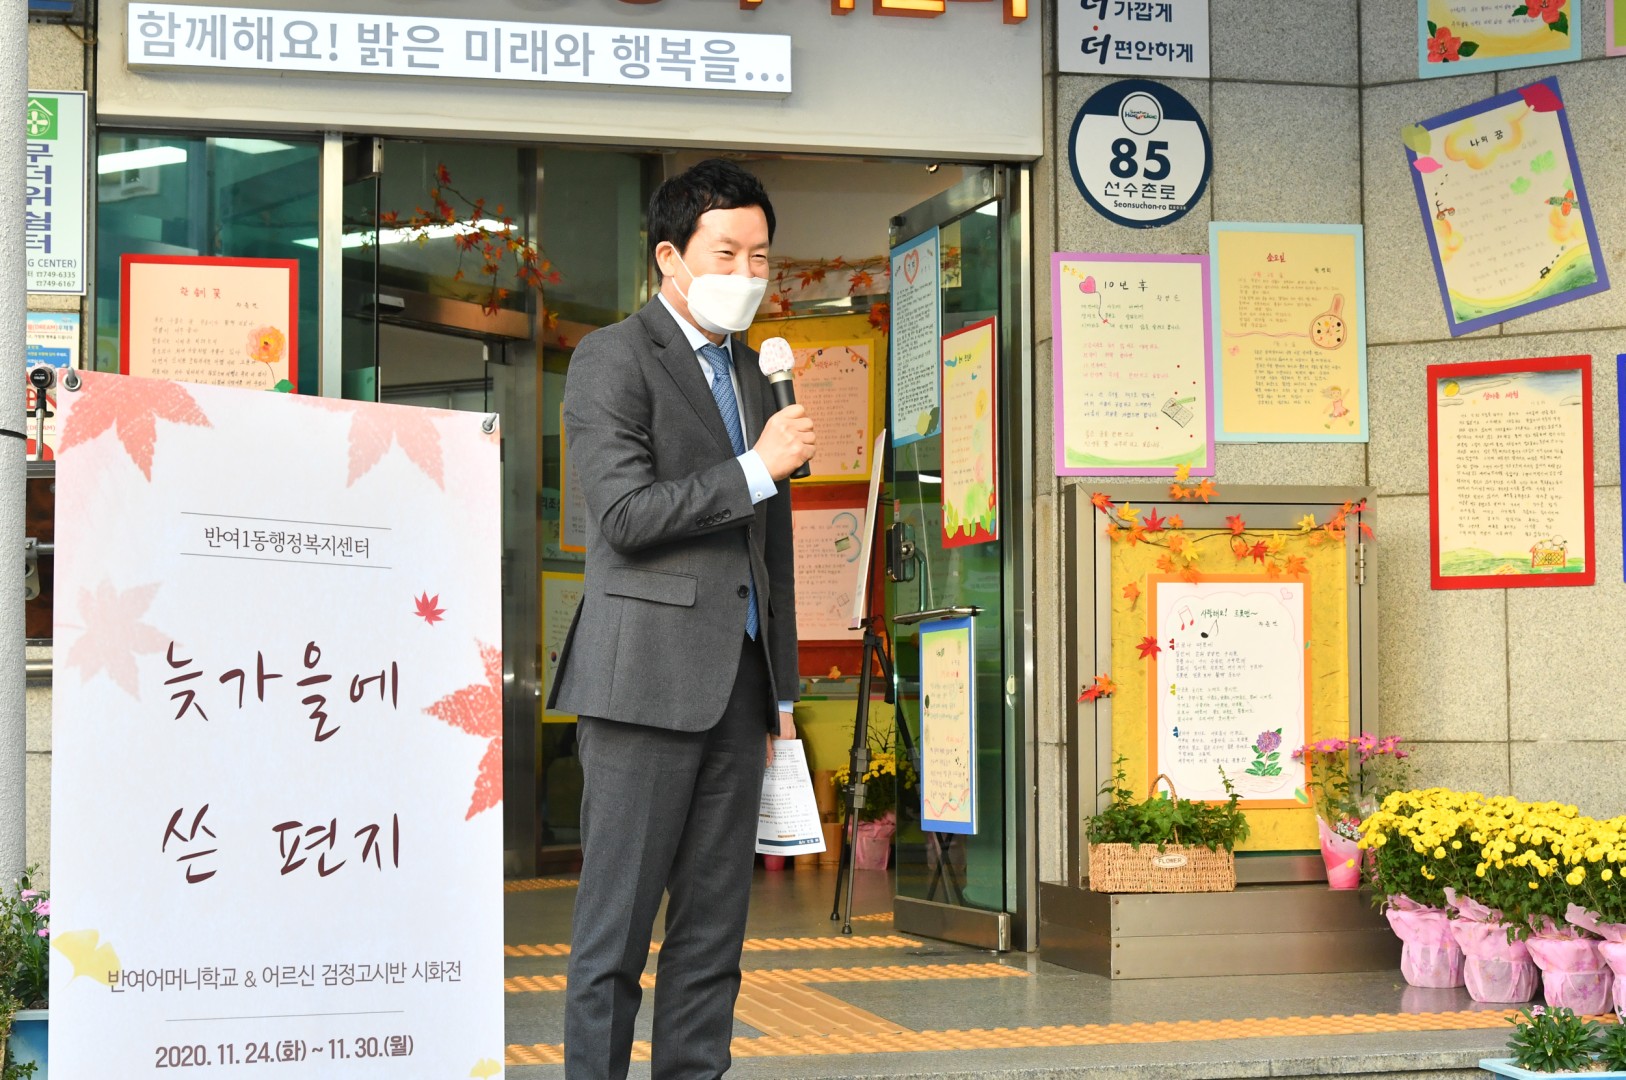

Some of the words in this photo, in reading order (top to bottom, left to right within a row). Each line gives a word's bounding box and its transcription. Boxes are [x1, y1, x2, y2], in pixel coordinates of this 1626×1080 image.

[1114, 1, 1173, 22] 가깝게
[136, 10, 340, 63] 함께해요!
[356, 22, 445, 69] 밝은
[464, 28, 596, 76] 미래와
[611, 33, 786, 84] 행복을...
[1081, 33, 1112, 65] 더
[1114, 40, 1194, 63] 편안하게
[1469, 134, 1489, 147] 나의
[1494, 129, 1504, 140] 꿈
[1109, 137, 1171, 181] 85
[1104, 181, 1176, 200] 선수촌로
[1113, 200, 1167, 211] Seonsuchon-ro
[38, 258, 77, 269] CENTER)
[1138, 280, 1148, 292] 후
[204, 526, 371, 559] 반여1동행정복지센터
[163, 640, 399, 742] 늦가을에
[162, 803, 218, 885] 쓴
[272, 812, 400, 878] 편지
[107, 966, 239, 993] 반여어머니학교
[244, 970, 257, 988] &
[262, 964, 316, 988] 어르신
[321, 962, 407, 987] 검정고시반
[411, 960, 463, 983] 시화전
[155, 1045, 212, 1069] 2020.
[217, 1043, 241, 1065] 11.
[245, 1039, 307, 1065] 24.(화)
[328, 1038, 351, 1060] 11.
[355, 1034, 414, 1059] 30.(월)
